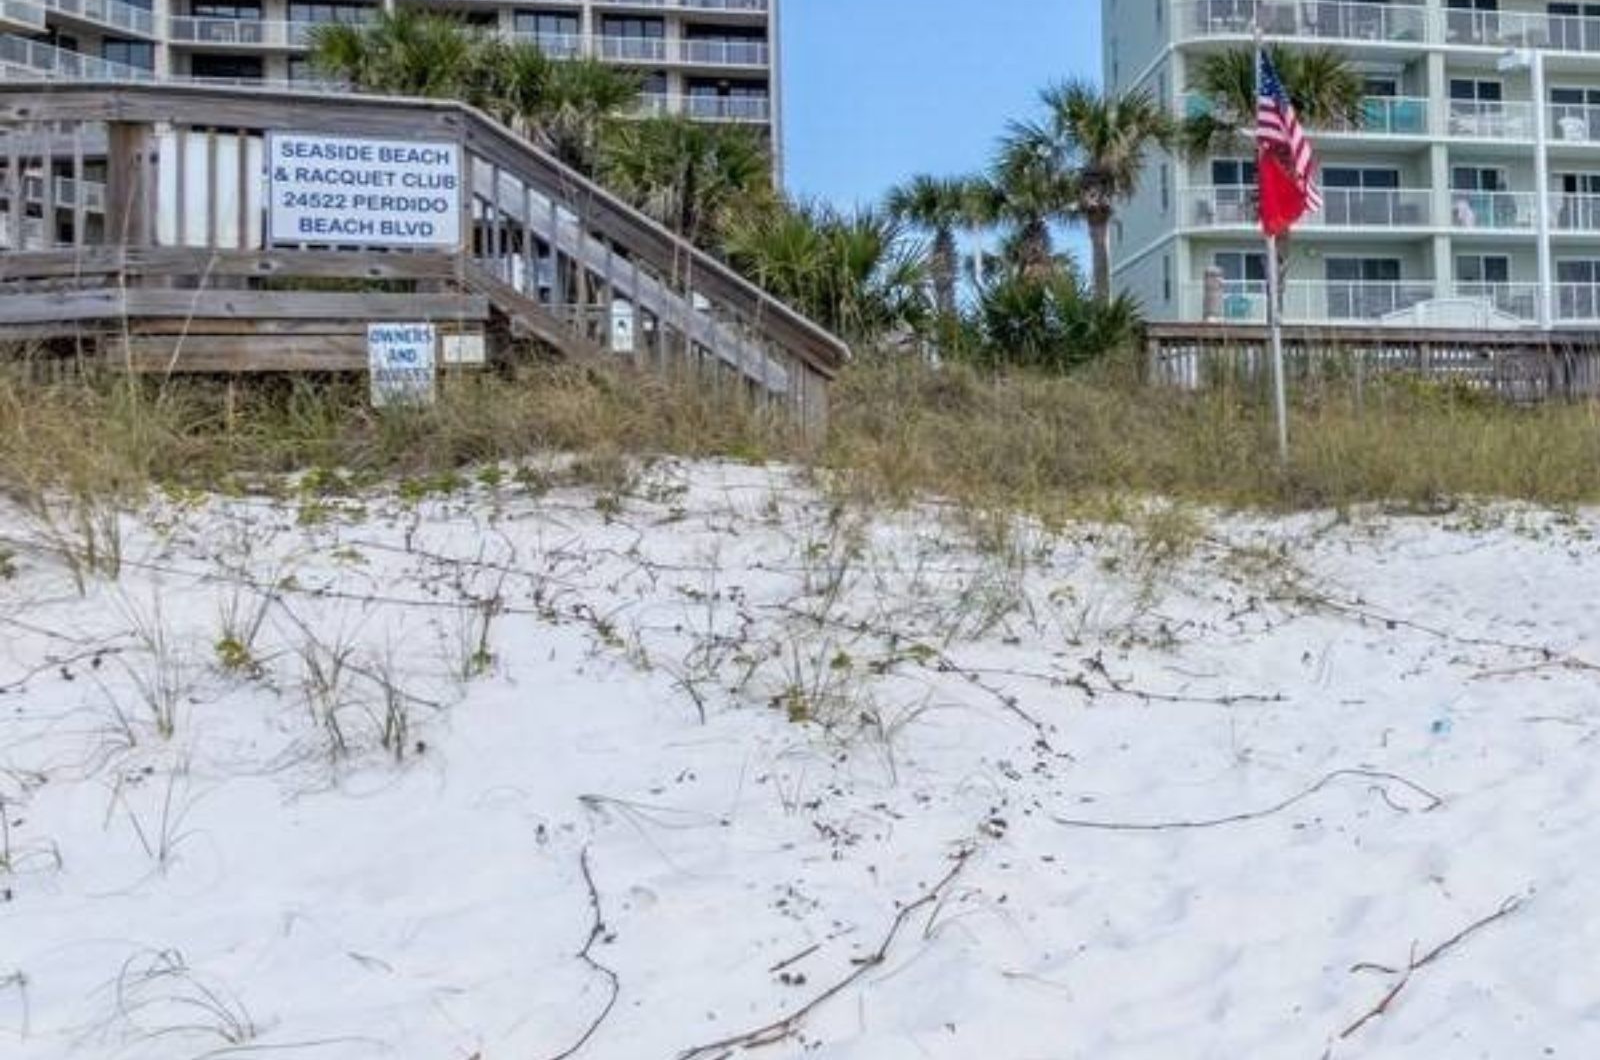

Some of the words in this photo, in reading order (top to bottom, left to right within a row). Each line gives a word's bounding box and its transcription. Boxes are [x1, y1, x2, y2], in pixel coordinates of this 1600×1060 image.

[281, 142, 374, 162] SEASIDE
[378, 147, 449, 165] BEACH
[274, 167, 289, 182] &
[295, 167, 396, 187] RACQUET
[402, 172, 457, 190] CLUB
[283, 191, 348, 209] 24522
[352, 194, 449, 213] PERDIDO
[298, 217, 375, 236] BEACH
[380, 220, 434, 237] BLVD
[369, 329, 432, 345] OWNERS
[388, 348, 417, 363] AND
